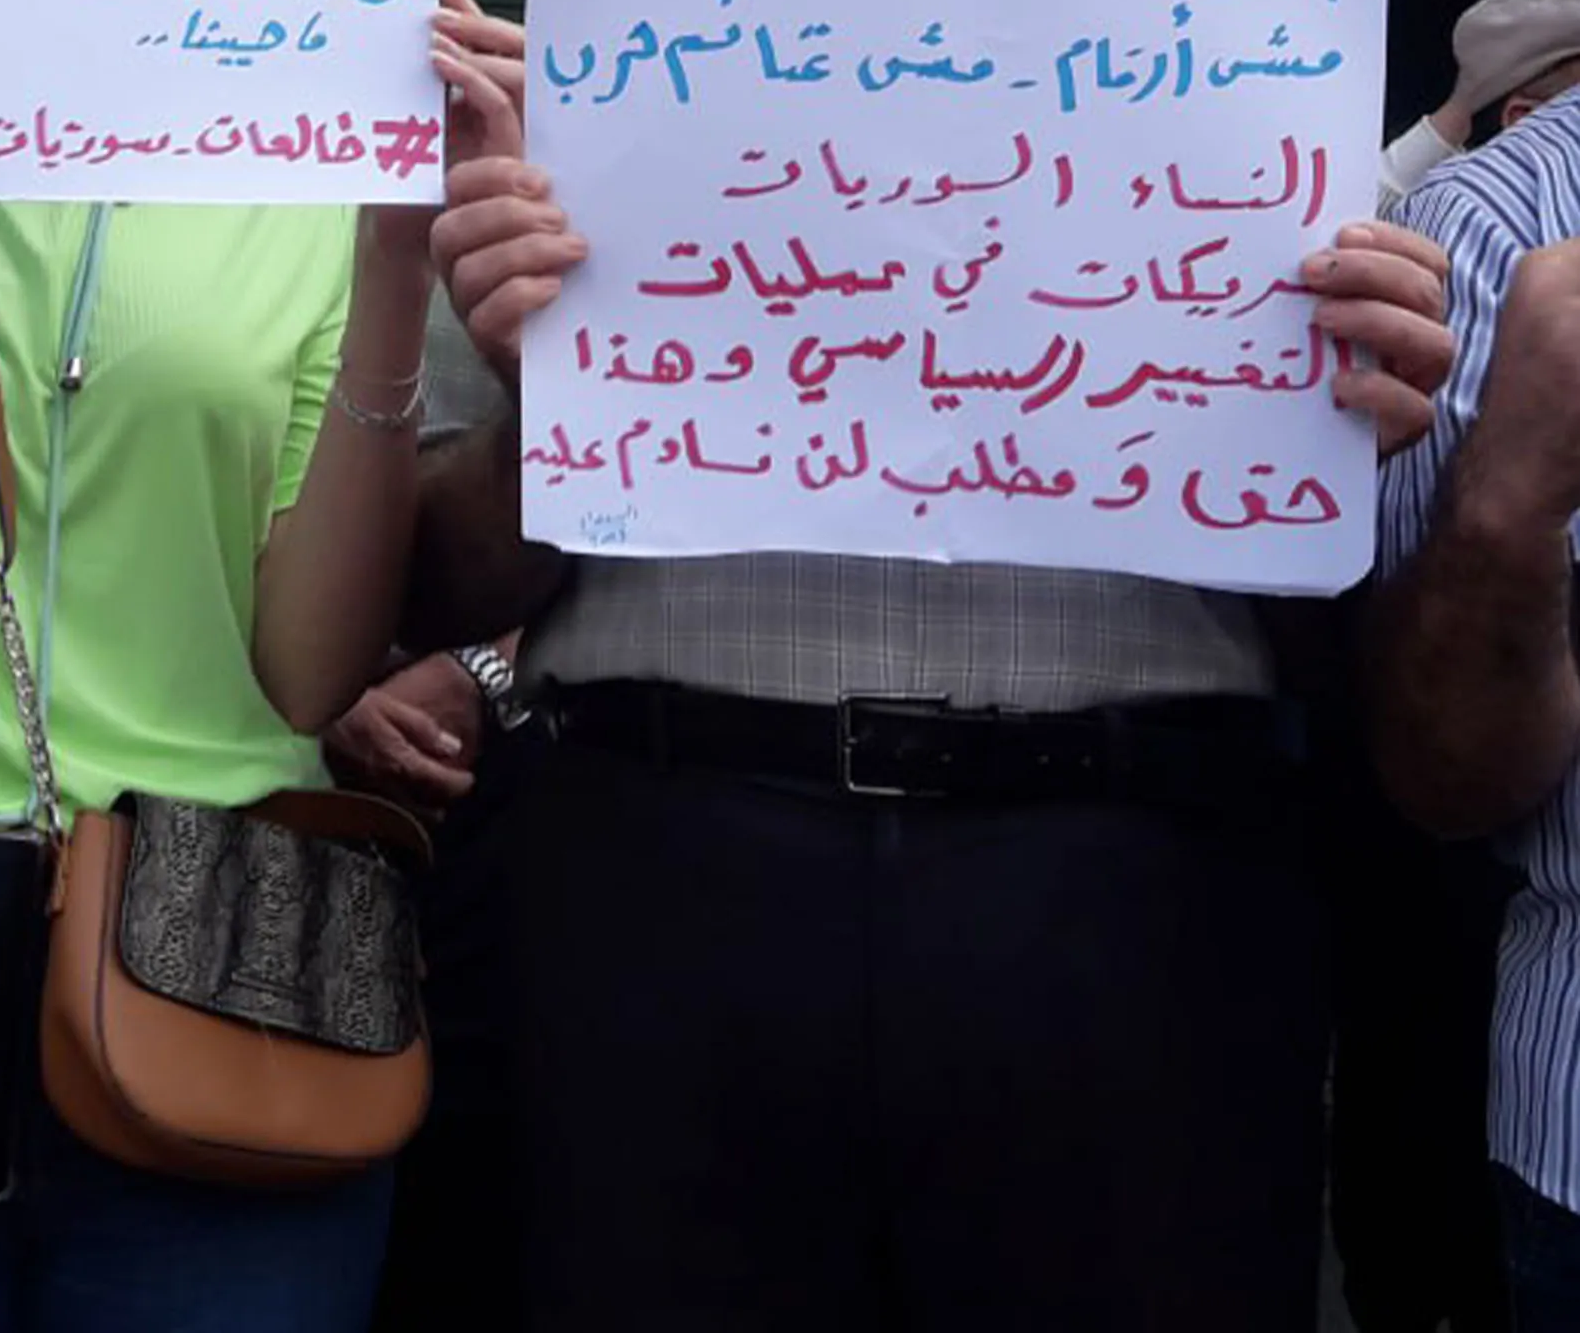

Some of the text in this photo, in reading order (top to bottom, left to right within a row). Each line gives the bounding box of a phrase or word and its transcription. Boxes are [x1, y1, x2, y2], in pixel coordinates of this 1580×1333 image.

[544, 20, 659, 104] حرب
[856, 22, 995, 92] مش
[1055, 2, 1194, 114] أرقام
[1207, 24, 1343, 88] مش
[721, 132, 1327, 227] النساء السوريات
[637, 216, 1309, 318] ريكات في عمليات
[788, 328, 1085, 415] السياسي
[522, 424, 606, 485] عليه
[617, 419, 772, 490] نساوم
[796, 419, 869, 491] لن
[880, 432, 1077, 517] مطلب
[1181, 464, 1340, 530] حق
